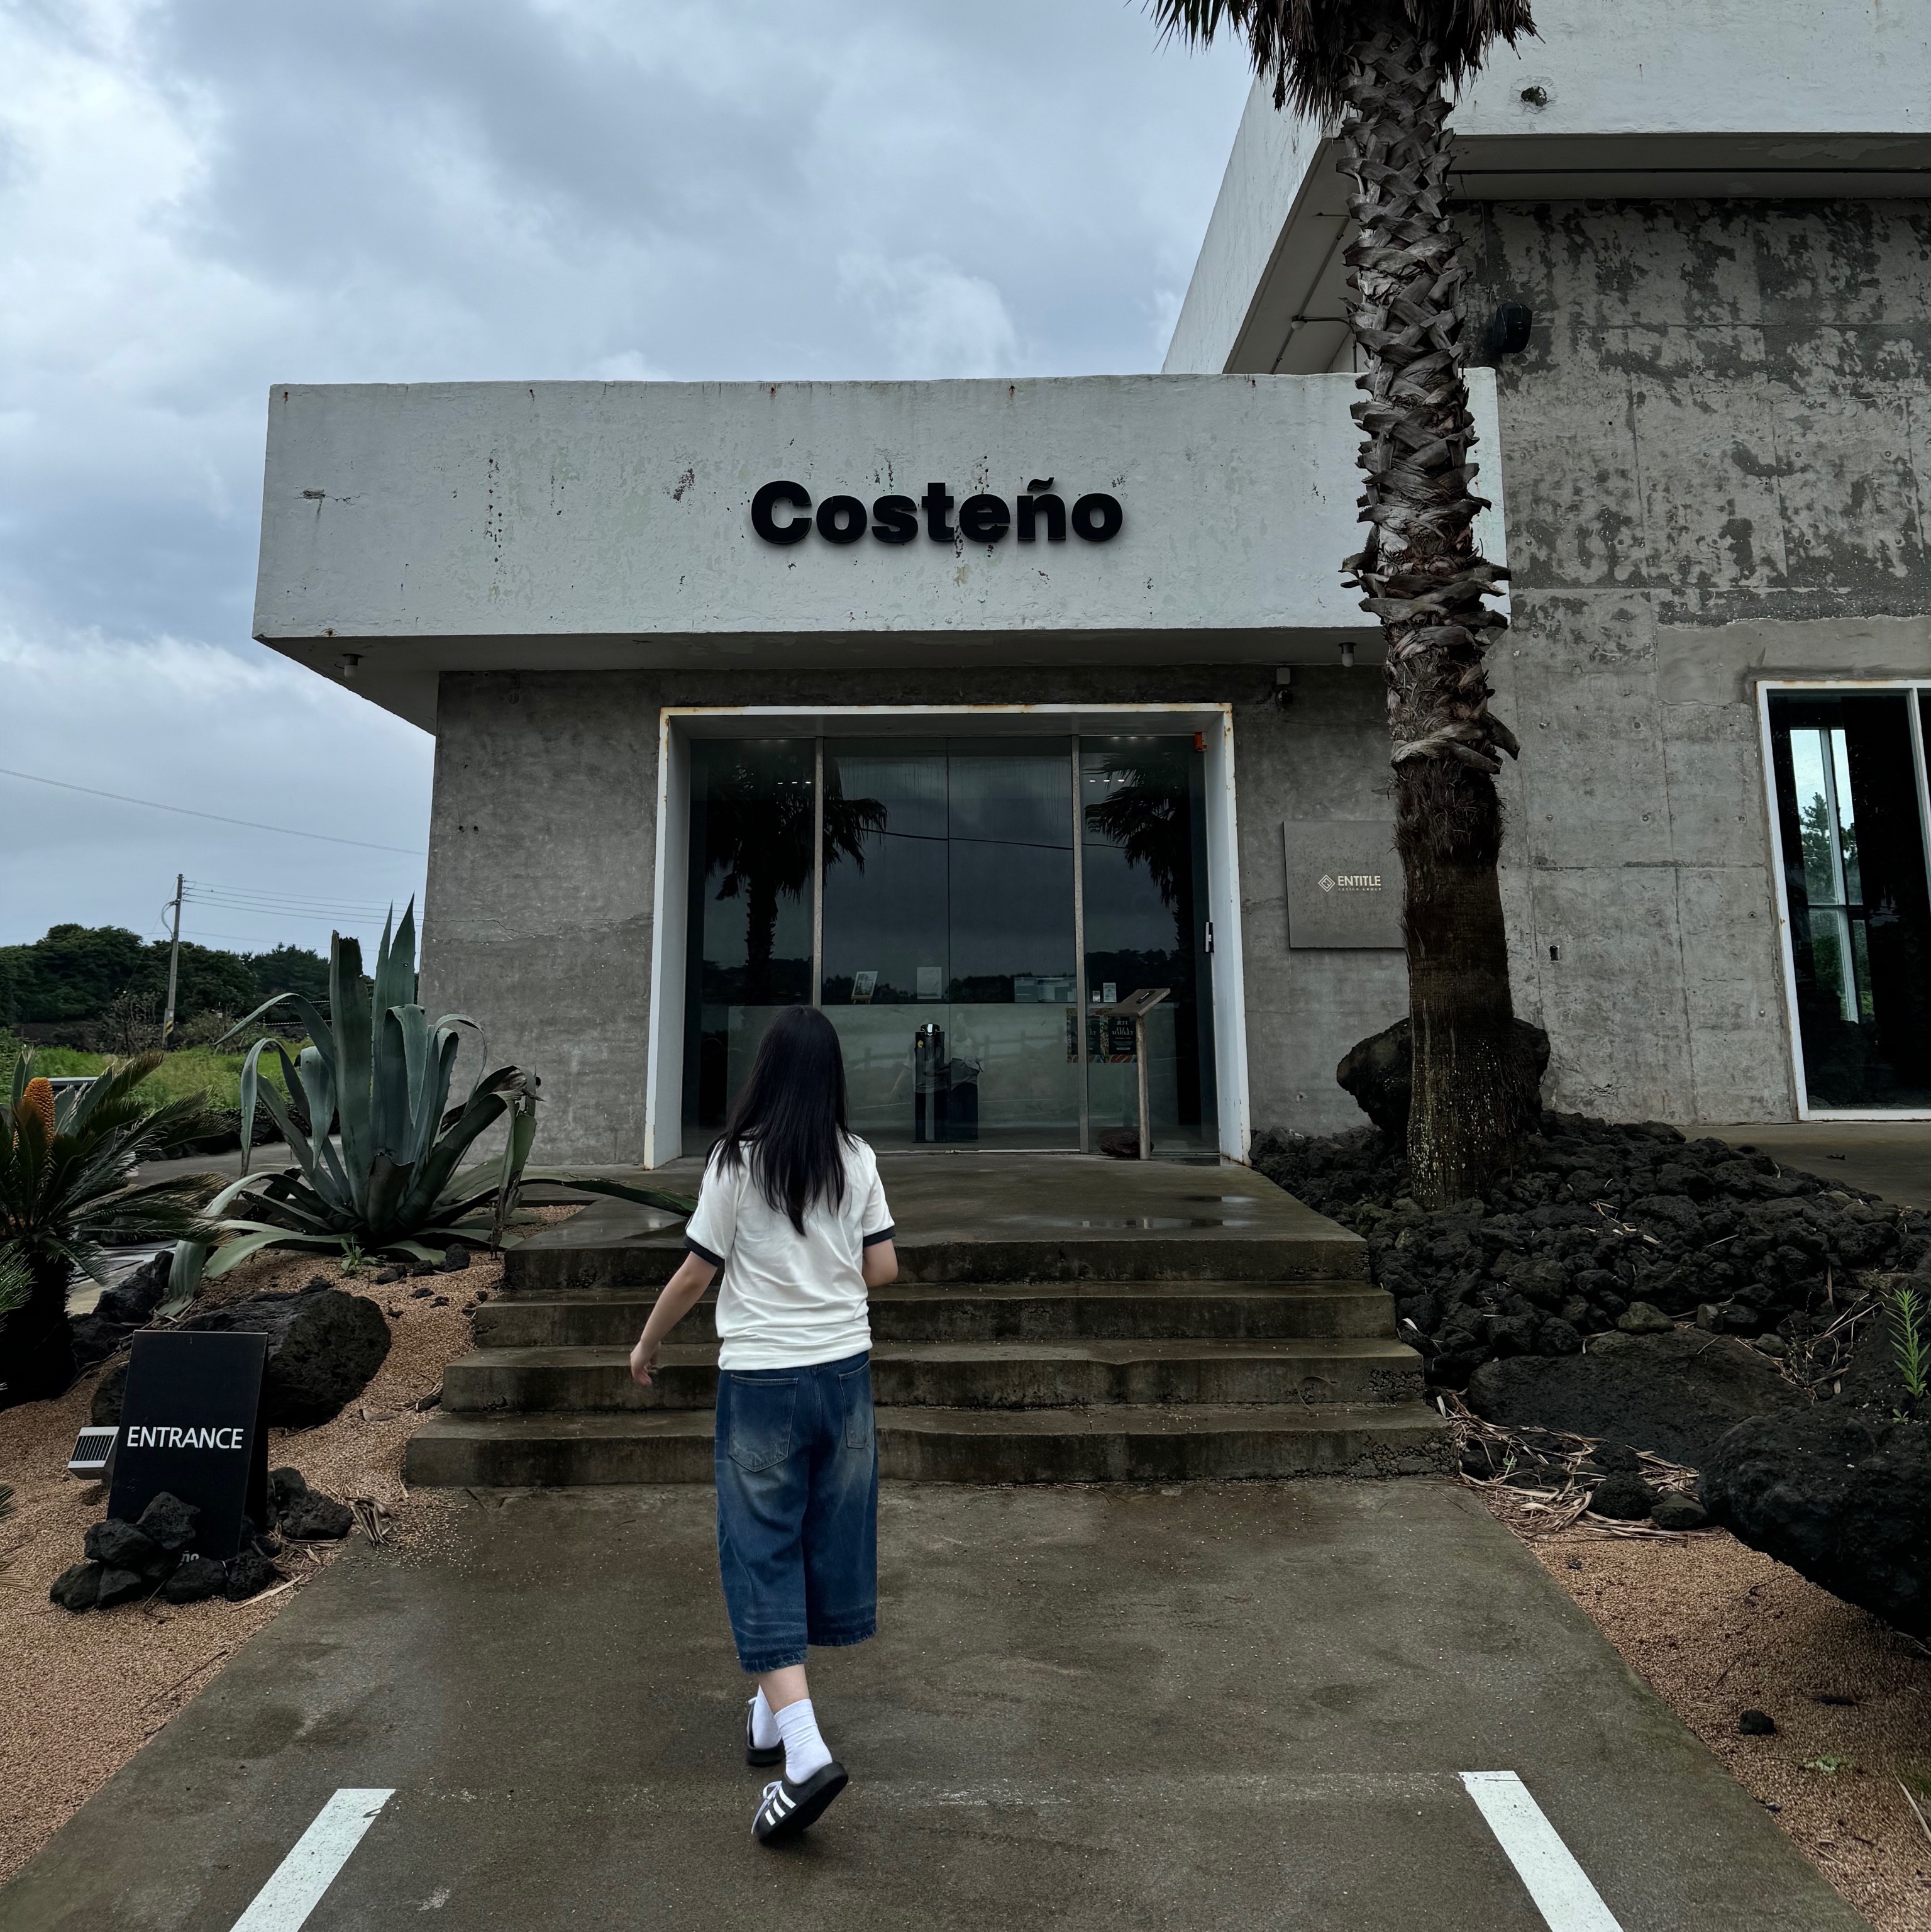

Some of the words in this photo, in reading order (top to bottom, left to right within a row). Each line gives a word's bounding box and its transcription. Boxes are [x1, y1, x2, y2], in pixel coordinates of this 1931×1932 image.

[751, 477, 1124, 545] Costeño
[1337, 875, 1381, 886] ENTITLE
[126, 1425, 244, 1449] ENTRANCE
